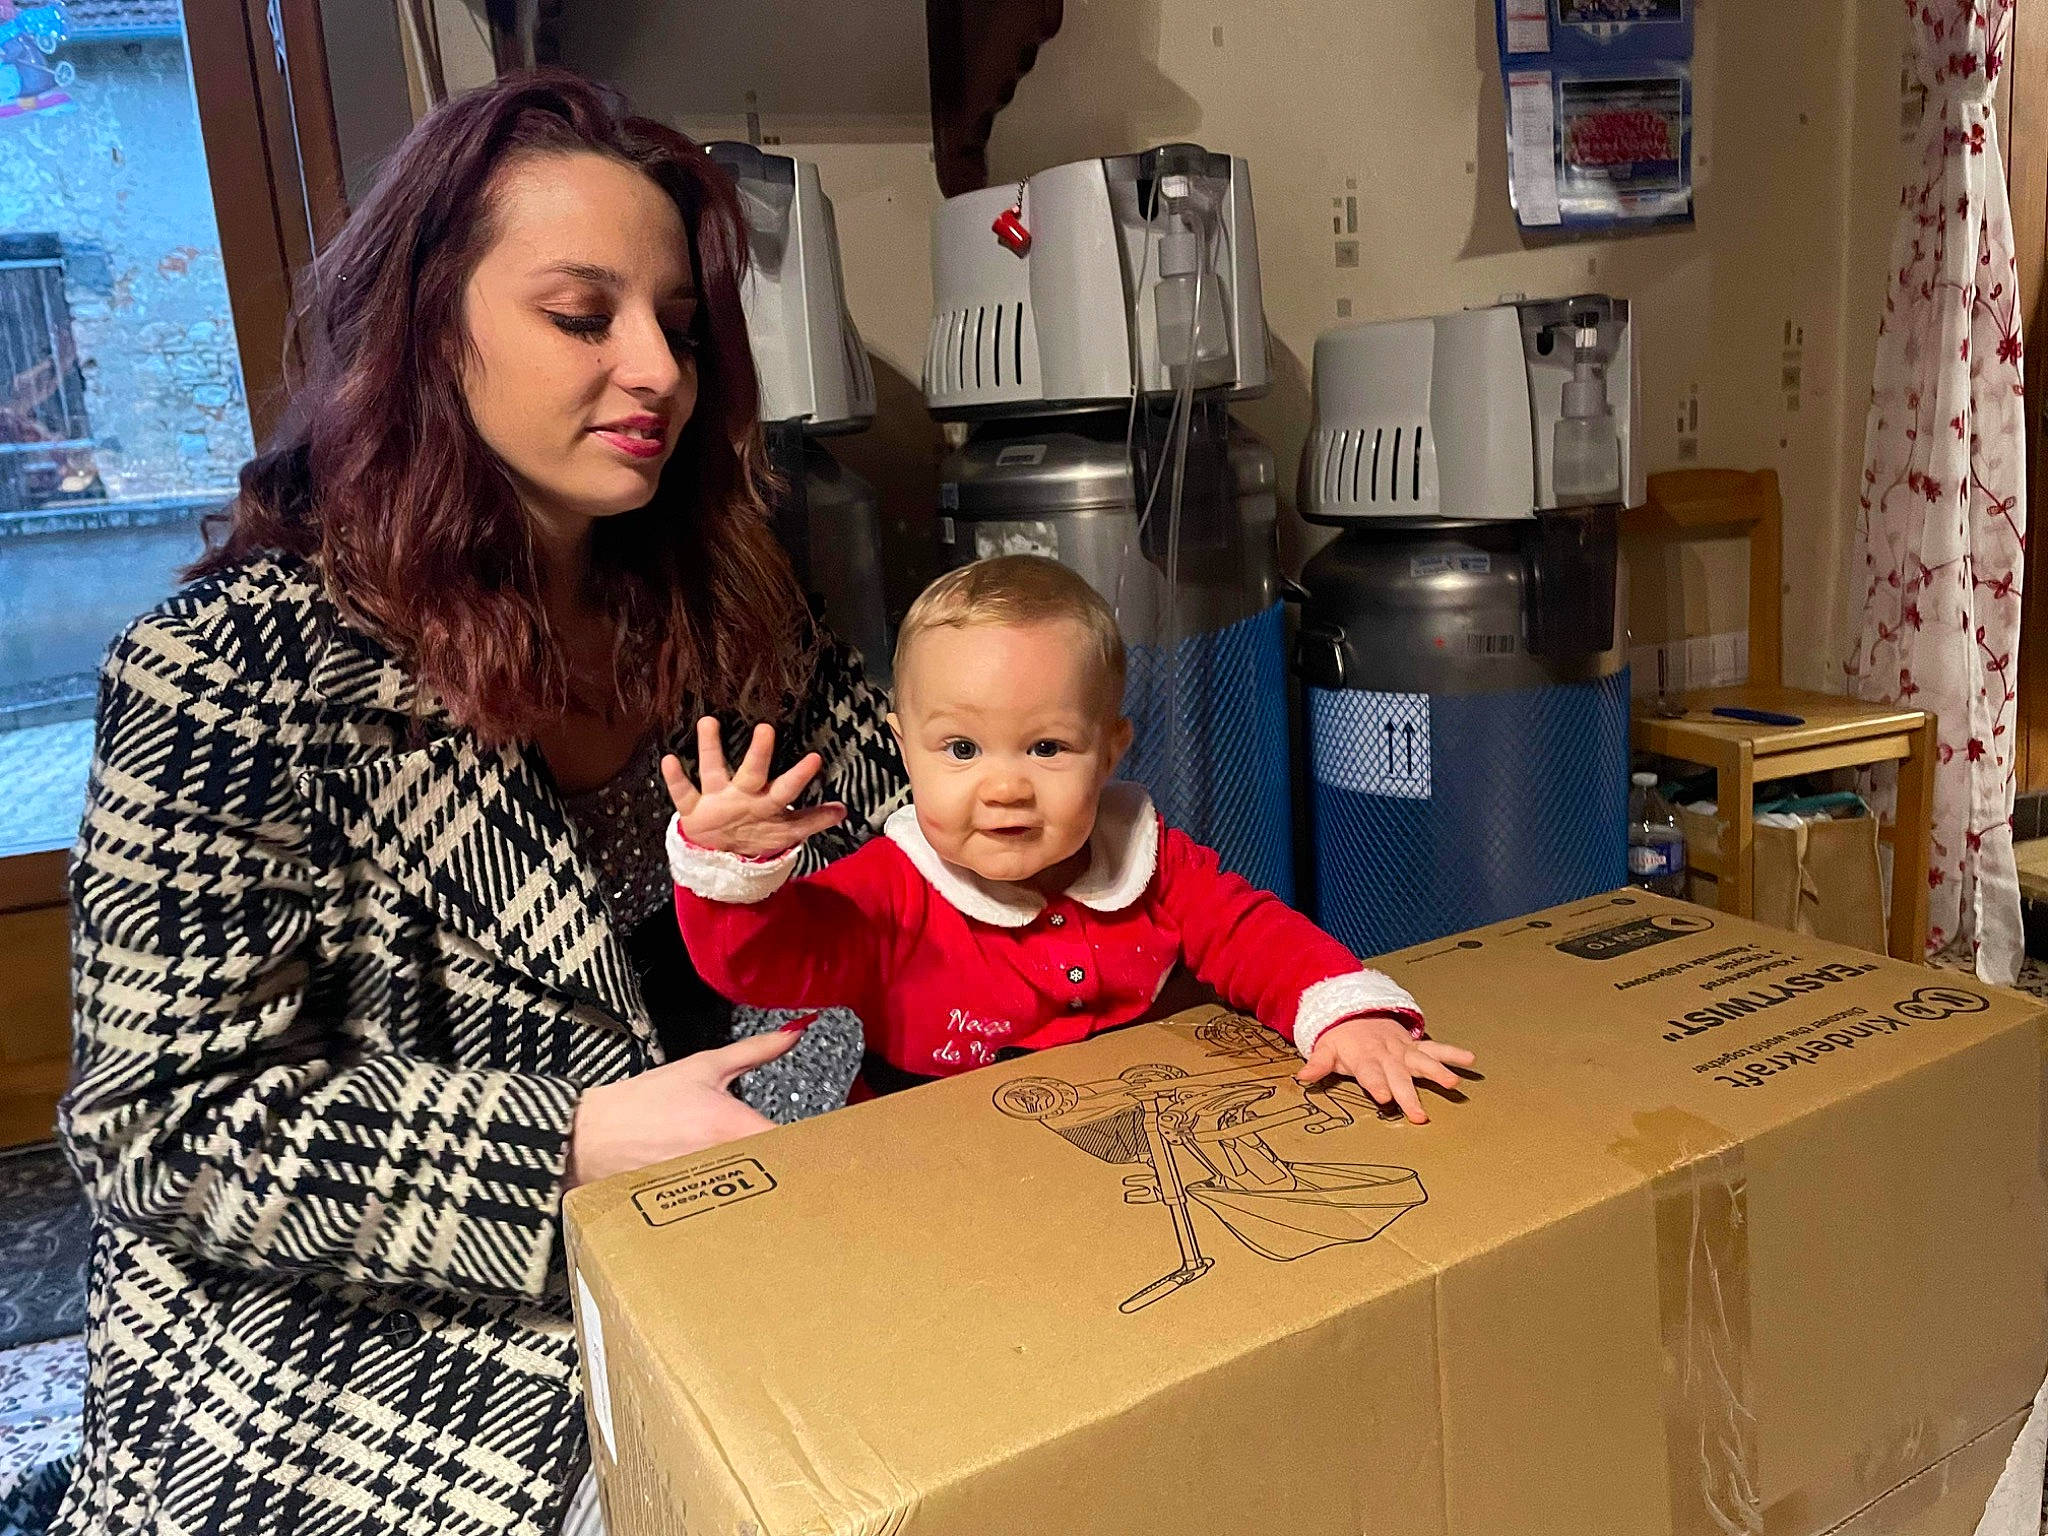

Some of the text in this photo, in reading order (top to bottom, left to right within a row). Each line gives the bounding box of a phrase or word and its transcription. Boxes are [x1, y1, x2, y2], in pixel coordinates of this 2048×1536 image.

[1586, 938, 1617, 951] TO
[1692, 1006, 1869, 1073] Discover the world together
[1714, 1014, 1912, 1089] Kinderkraft
[655, 1169, 745, 1202] warranty
[660, 1178, 755, 1210] 10 years
